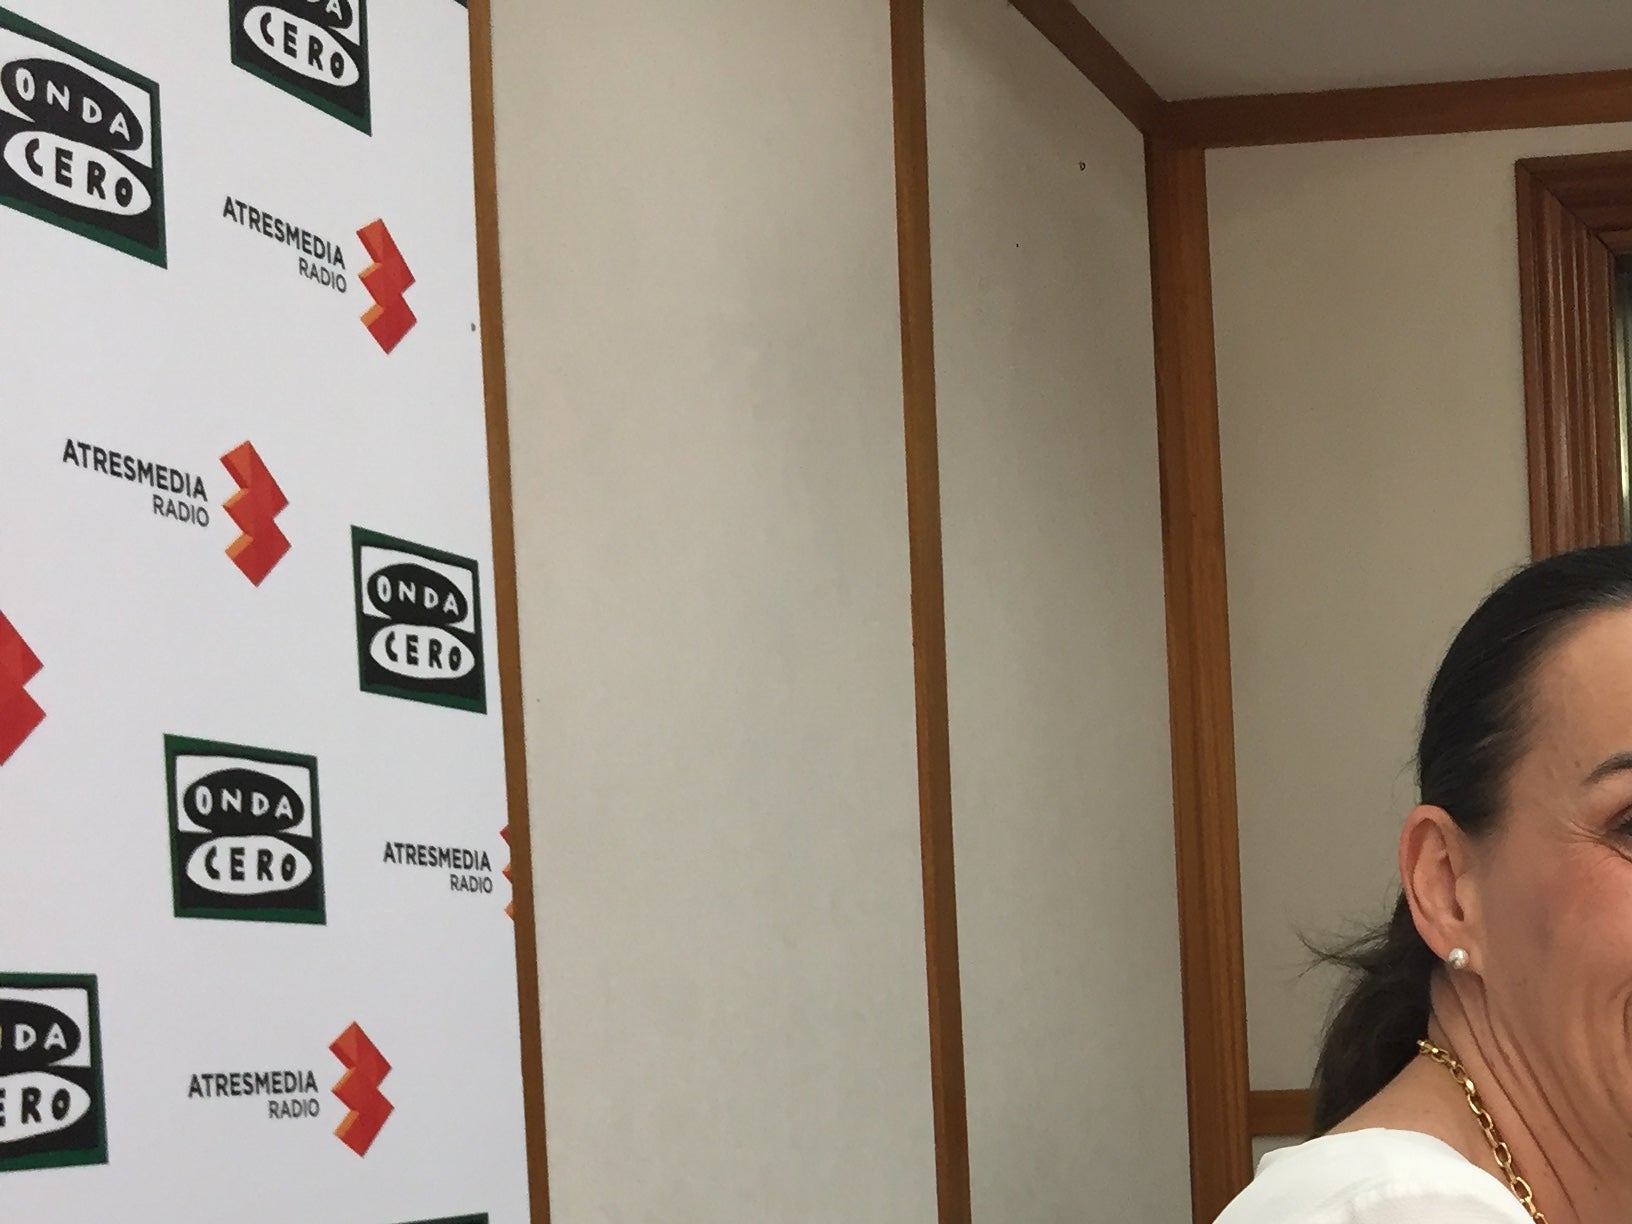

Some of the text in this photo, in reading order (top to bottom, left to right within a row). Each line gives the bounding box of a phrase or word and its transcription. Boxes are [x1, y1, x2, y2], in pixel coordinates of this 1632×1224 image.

[260, 11, 345, 79] CERO
[14, 67, 131, 142] ONDA
[25, 137, 134, 207] CERO
[222, 196, 346, 270] ATRESMEDIA
[298, 257, 348, 294] RADIO
[62, 438, 208, 501] ATRESMEDIA
[152, 494, 210, 527] RADIO
[376, 574, 460, 616] ONDA
[385, 630, 463, 672] CERO
[195, 785, 294, 820] ONDA
[204, 845, 298, 882] CERO
[382, 841, 492, 873] ATRESMEDIA
[450, 873, 494, 894] RADIO
[0, 1022, 68, 1052] DA
[187, 1071, 319, 1099] ATRESMEDIA
[0, 1086, 71, 1128] RO
[268, 1098, 321, 1120] RADIO
